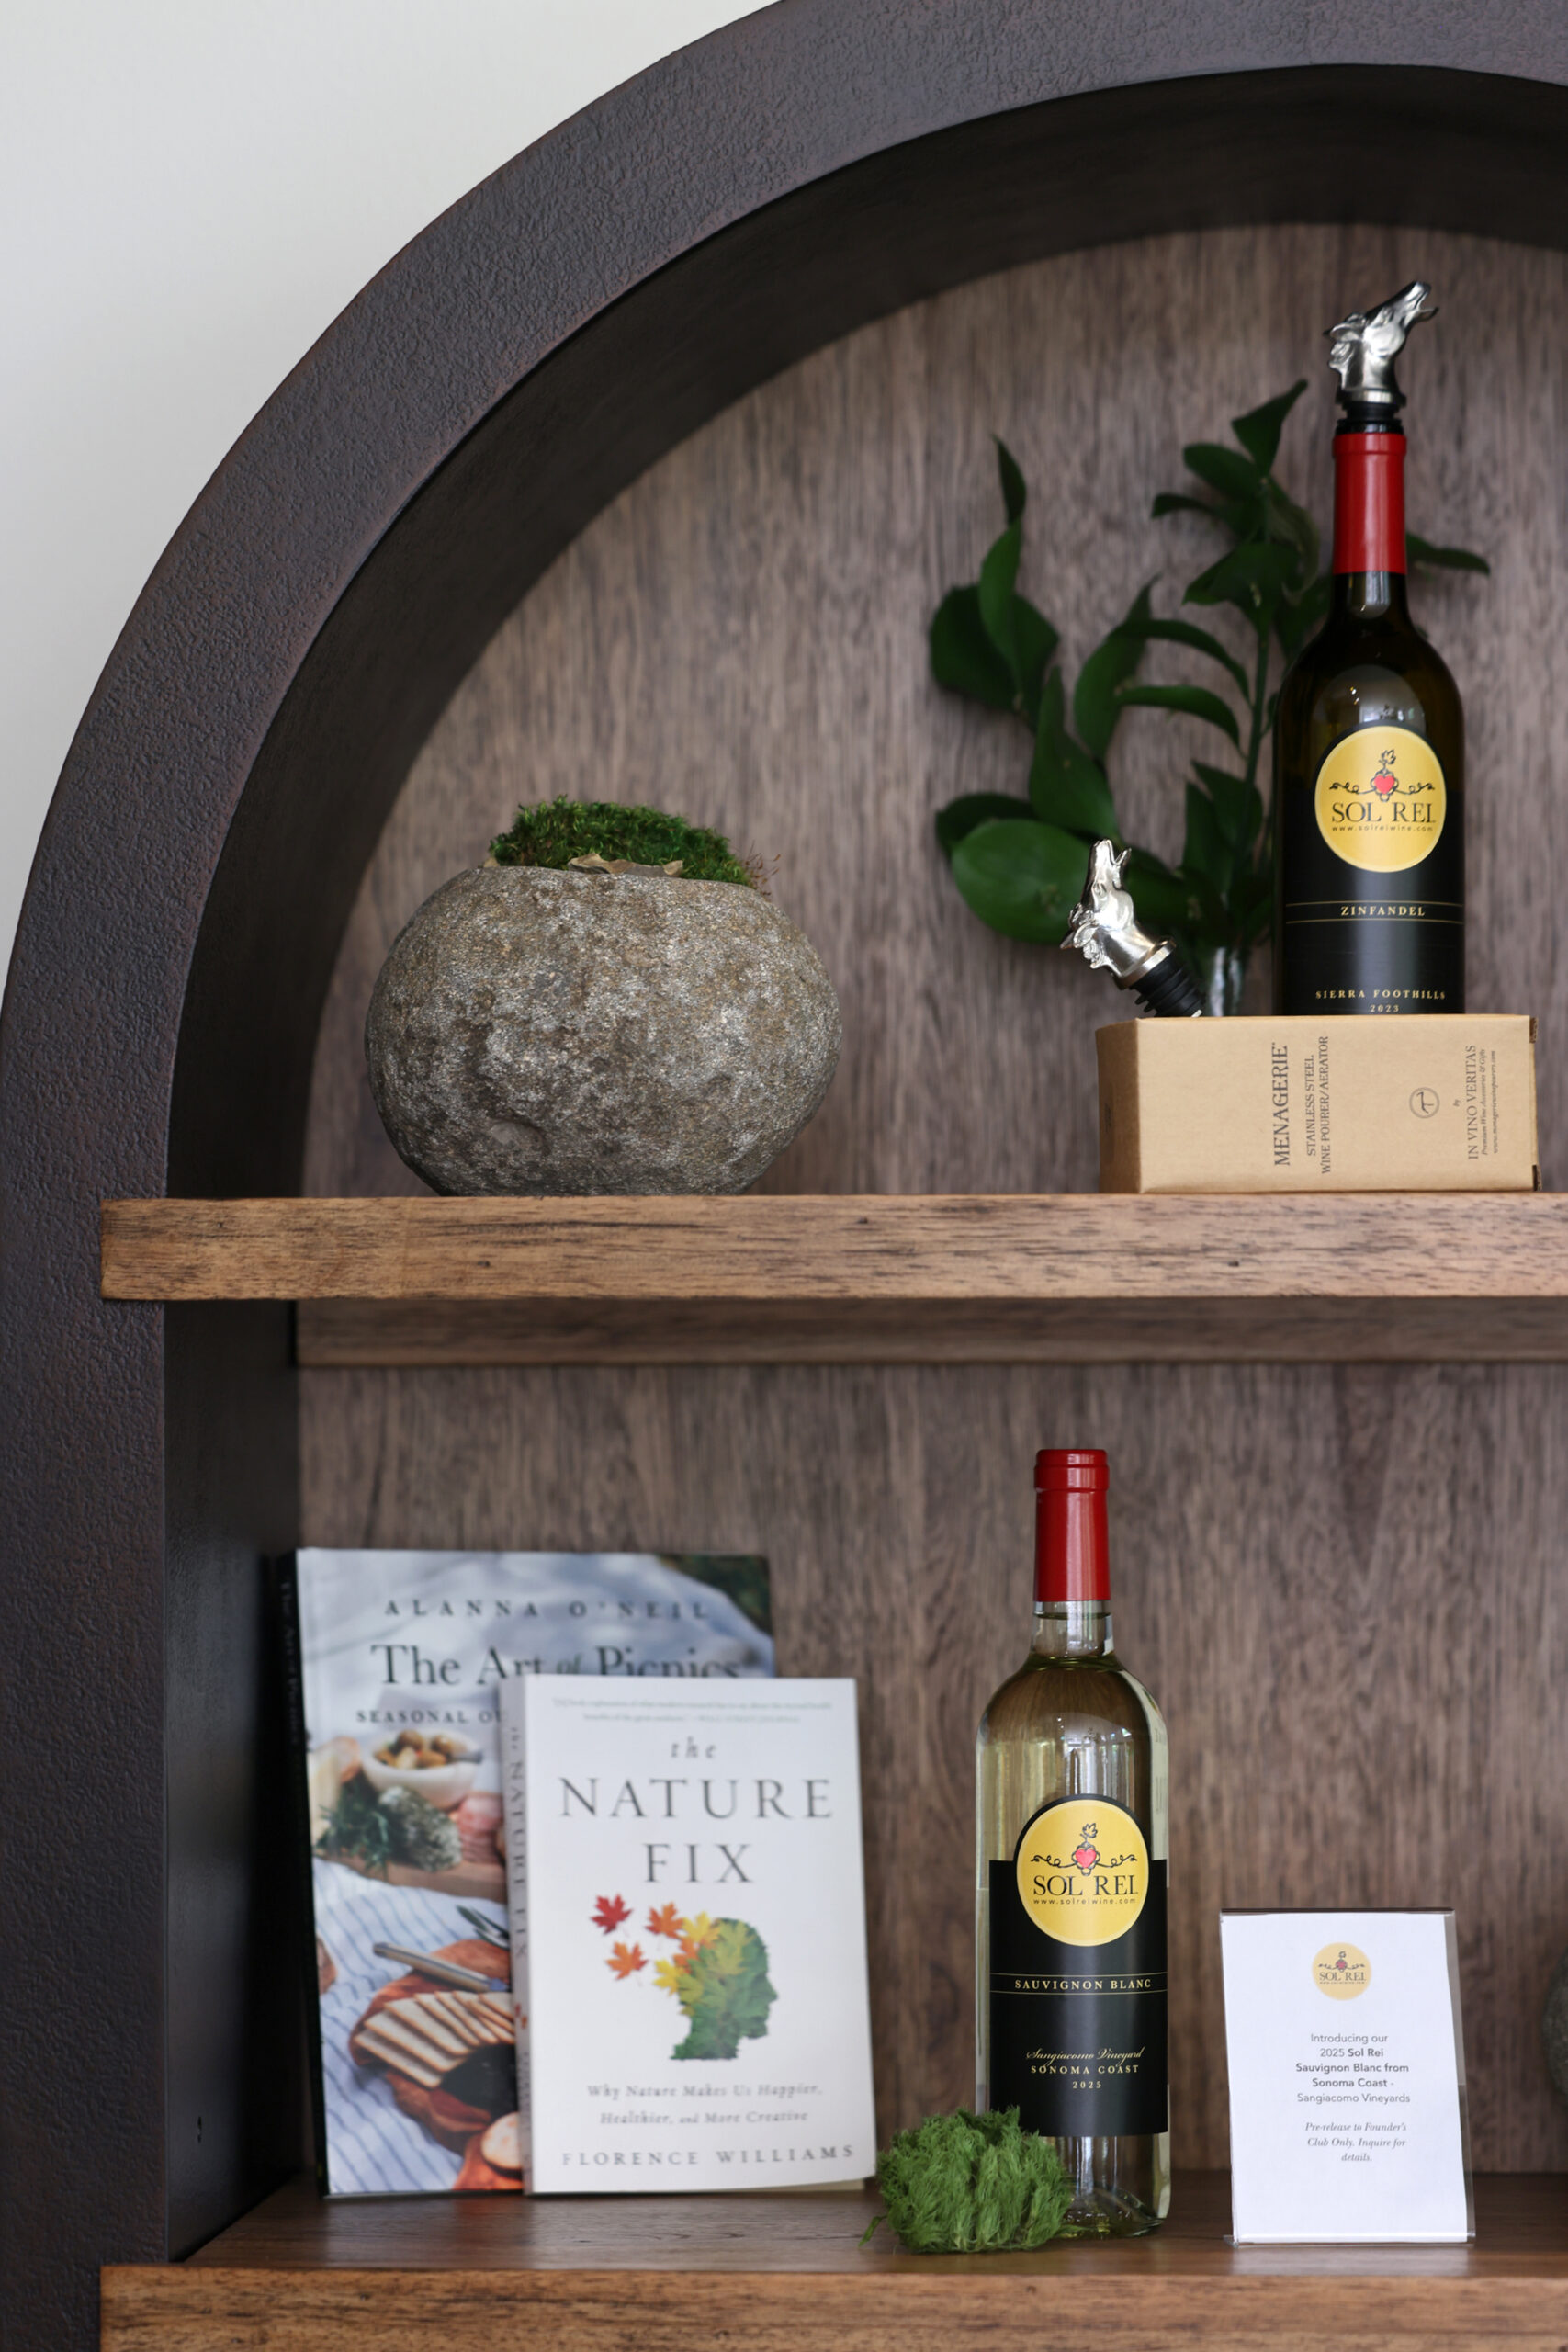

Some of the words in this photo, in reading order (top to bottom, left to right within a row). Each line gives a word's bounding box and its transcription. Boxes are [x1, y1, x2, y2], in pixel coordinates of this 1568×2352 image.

[1332, 801, 1382, 823] SOL
[1392, 801, 1436, 823] REI
[1332, 823, 1433, 831] www.solreiwine.com
[1340, 906, 1425, 916] ZINFANDEL
[1315, 989, 1365, 1000] SIERRA
[1373, 989, 1446, 1000] FOOTHILLS
[1370, 1004, 1399, 1012] 2023
[1304, 1055, 1314, 1091] STEEL
[1465, 1045, 1477, 1102] VERITAS
[1318, 1036, 1330, 1143] POURER/AERATOR
[1271, 1045, 1290, 1166] MENAGERIE
[1305, 1093, 1316, 1157] STAINLESS
[1466, 1105, 1478, 1141] VINO
[1468, 1145, 1478, 1159] IN
[1320, 1145, 1331, 1174] WINE
[385, 1600, 539, 1617] ALANNA
[569, 1600, 709, 1619] O'NEIL
[370, 1645, 462, 1684] The
[477, 1646, 546, 1685] Art
[595, 1645, 743, 1677] Picnics
[356, 1710, 469, 1724] SEASONAL
[671, 1736, 717, 1758] the
[558, 1777, 833, 1819] NATURE
[643, 1842, 754, 1884] FIX
[1033, 1875, 1083, 1896] SOL
[1093, 1874, 1138, 1895] REI
[1319, 1972, 1341, 1981] SOL
[1015, 1980, 1102, 1989] SAUVIGNON
[1111, 1979, 1151, 1989] BLANC
[1311, 2033, 1369, 2044] Introducing
[1026, 2048, 1095, 2066] Sangiacomo
[1097, 2046, 1145, 2066] Vineyard
[1320, 2048, 1345, 2057] 2025
[1348, 2048, 1364, 2057] Sol
[1368, 2048, 1384, 2057] Rei
[1031, 2065, 1090, 2075] SONOMA
[1098, 2065, 1139, 2074] COAST
[1296, 2063, 1350, 2075] Sauvignon
[1353, 2063, 1382, 2072] Blanc
[1384, 2063, 1409, 2072] from
[1072, 2081, 1102, 2089] 2025
[1312, 2078, 1355, 2087] Sonoma
[1358, 2078, 1388, 2087] Coast
[588, 2084, 620, 2100] Why
[626, 2084, 677, 2097] Nature
[682, 2084, 727, 2097] Makes
[758, 2083, 823, 2099] Happier,
[1297, 2093, 1359, 2105] Sangiacomo
[1361, 2093, 1411, 2105] Vineyards
[600, 2112, 673, 2125] Healthier,
[704, 2112, 740, 2124] More
[746, 2111, 808, 2123] Creative
[1305, 2122, 1351, 2132] Pre-release
[1354, 2123, 1362, 2132] to
[1364, 2122, 1406, 2132] Founder's
[1307, 2138, 1328, 2147] Club
[1332, 2138, 1355, 2149] Only.
[1359, 2138, 1392, 2149] Inquire
[1392, 2138, 1406, 2149] for
[562, 2152, 699, 2166] FLORENCE
[716, 2144, 854, 2164] WILLIAMS
[1341, 2153, 1372, 2162] details.
